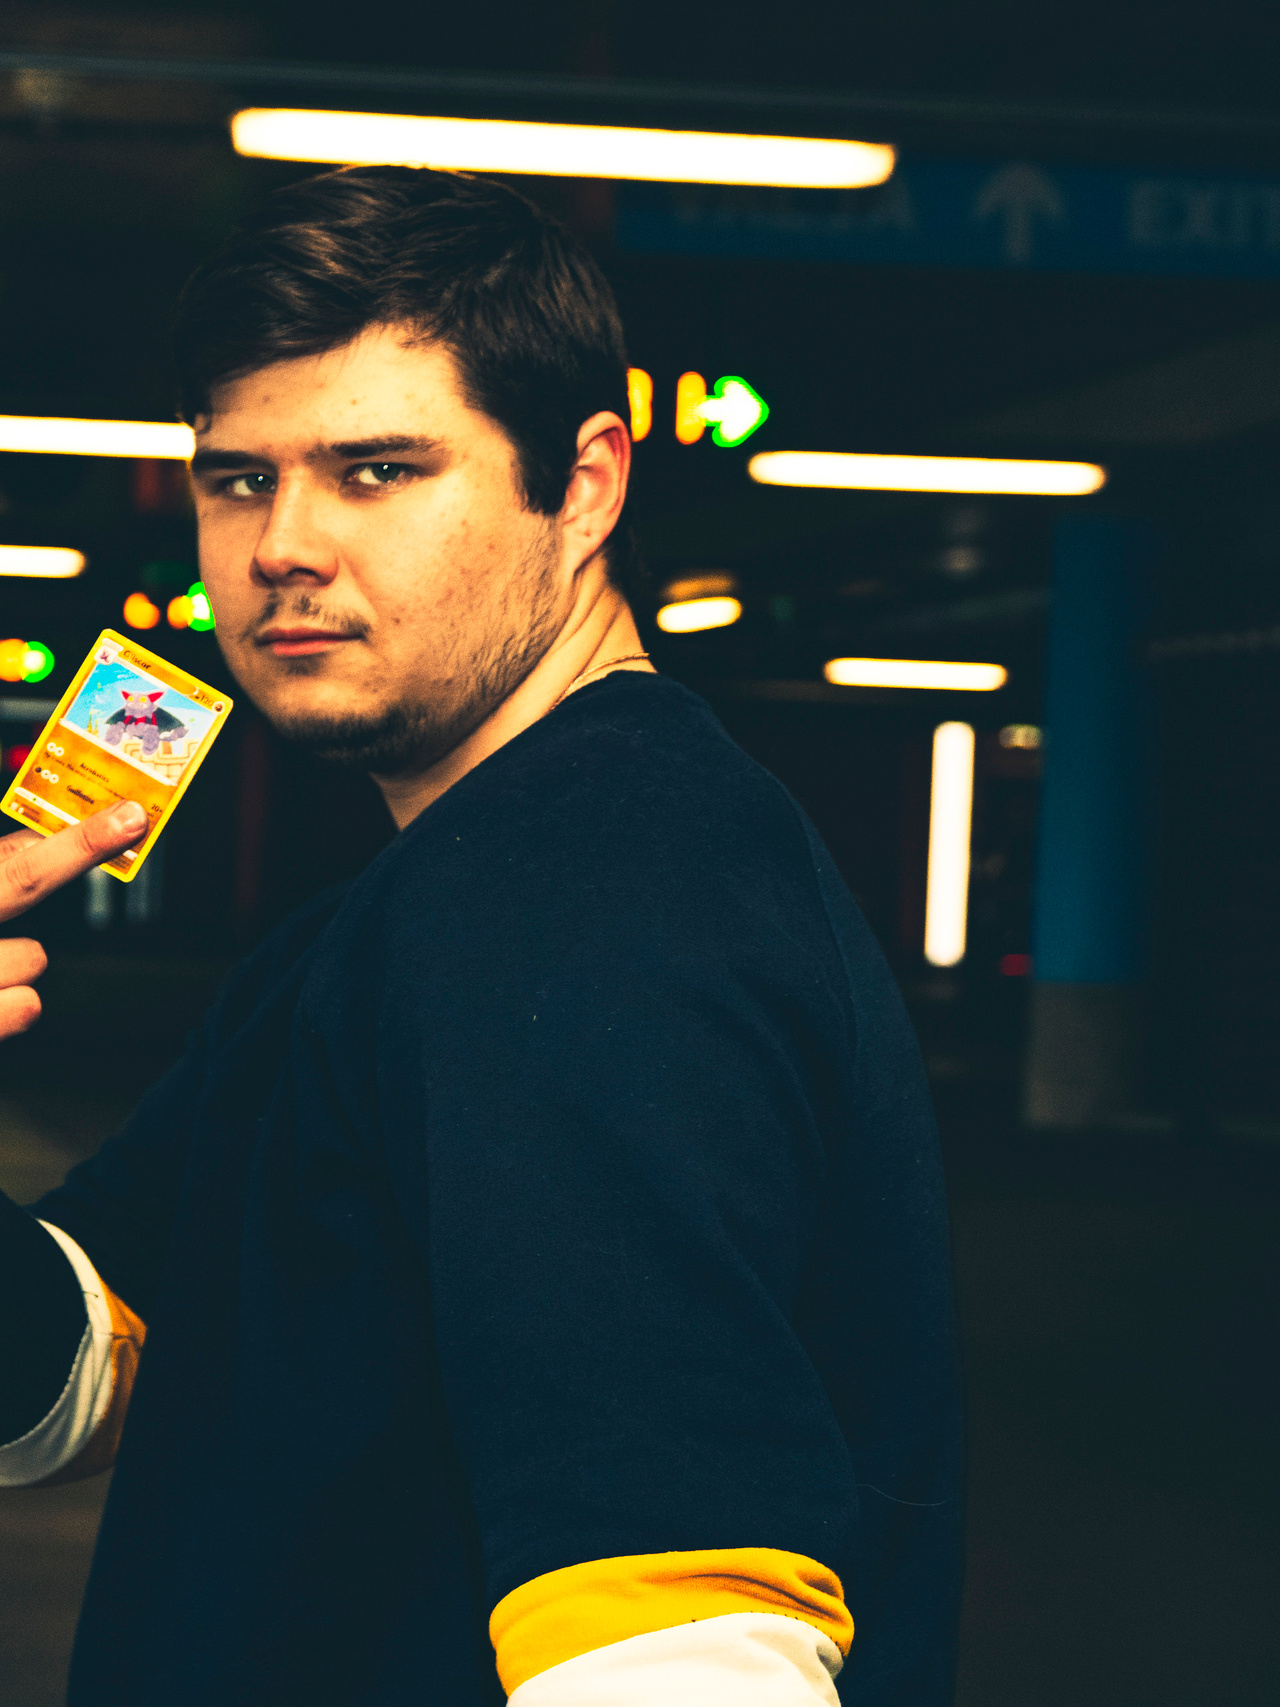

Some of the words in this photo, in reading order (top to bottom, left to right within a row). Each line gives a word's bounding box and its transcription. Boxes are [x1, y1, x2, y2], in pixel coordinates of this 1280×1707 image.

[122, 648, 152, 670] Gliscor
[199, 694, 214, 707] 120
[65, 783, 95, 805] Guillotine
